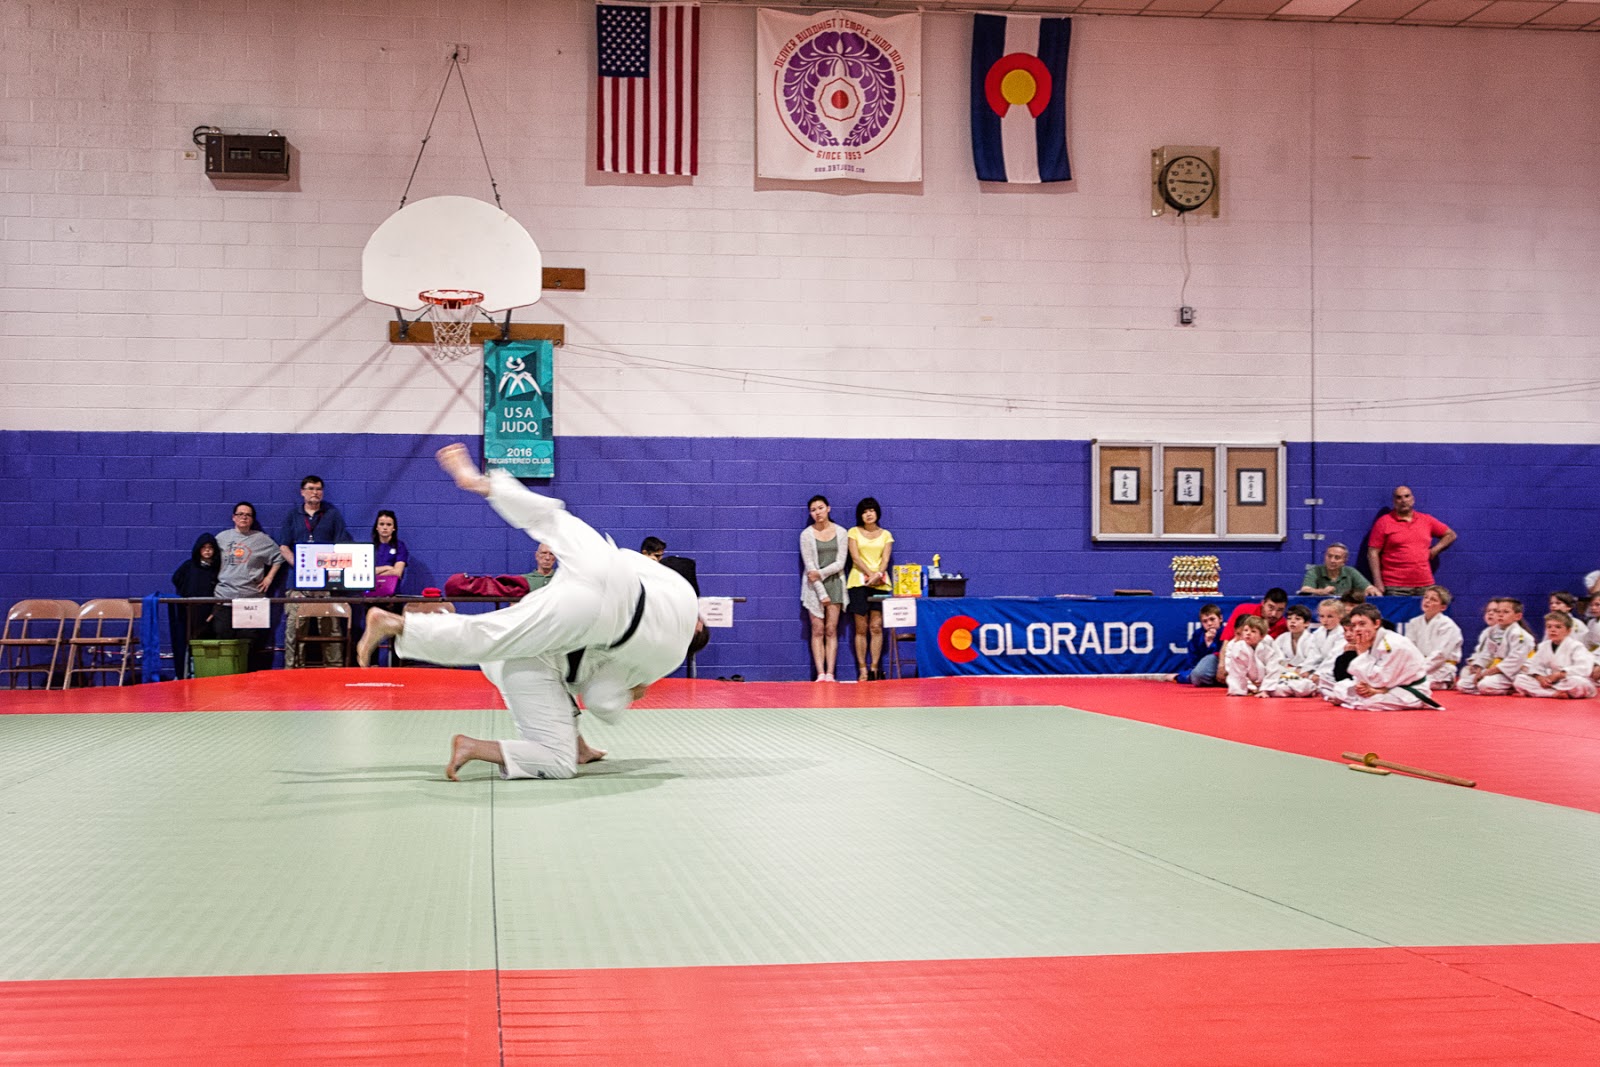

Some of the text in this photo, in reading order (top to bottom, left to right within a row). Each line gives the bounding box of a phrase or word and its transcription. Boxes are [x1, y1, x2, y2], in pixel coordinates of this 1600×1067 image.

[774, 18, 905, 72] DENVER BUDDHIST TEMPLE JUDO DOJO
[816, 150, 862, 160] SINCE 1953
[504, 407, 534, 418] USA
[500, 421, 538, 433] JUDO
[506, 447, 533, 457] 2016
[938, 615, 1154, 664] COLORADO
